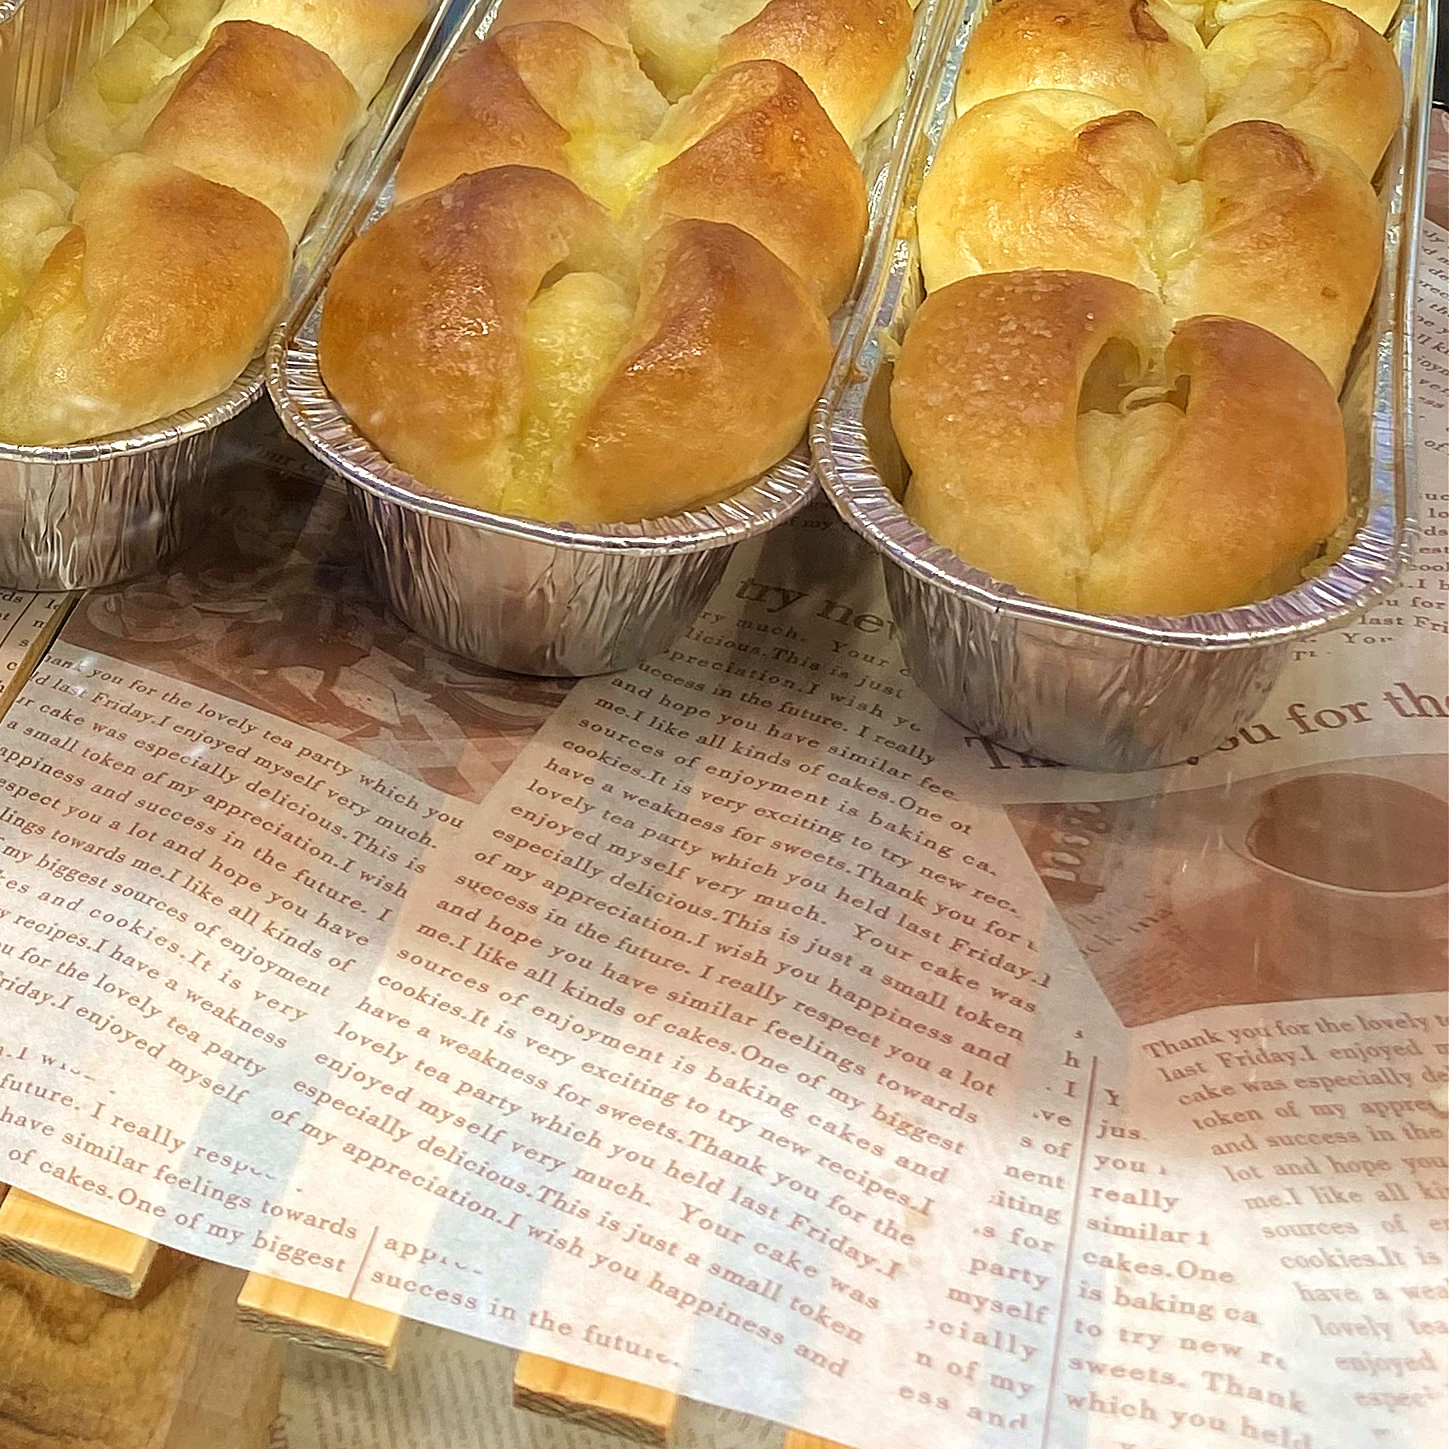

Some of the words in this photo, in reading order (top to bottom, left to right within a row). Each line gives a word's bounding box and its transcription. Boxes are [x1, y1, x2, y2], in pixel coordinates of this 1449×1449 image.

[50, 675, 88, 698] last
[173, 725, 252, 759] enjoyed
[253, 756, 326, 792] myself
[328, 789, 371, 817] very
[1286, 702, 1372, 734] for
[1383, 682, 1449, 718] th
[526, 779, 597, 814] lovely
[602, 810, 635, 829] tea
[638, 827, 703, 856] party
[711, 852, 778, 878] which
[783, 873, 828, 894] you
[835, 886, 891, 920] held
[896, 912, 942, 944] last
[107, 943, 160, 979] have
[164, 979, 178, 991] a
[186, 989, 286, 1048] weakness
[454, 875, 539, 914] success
[544, 908, 568, 928] in
[574, 922, 610, 944] the
[698, 965, 715, 980] I
[716, 975, 788, 1006] really
[792, 1000, 881, 1048] respect
[884, 1045, 932, 1071] you
[938, 1067, 953, 1080] a
[960, 1070, 996, 1097] lot
[8, 1149, 37, 1165] of
[174, 1213, 204, 1230] of
[205, 1223, 246, 1246] my
[251, 1229, 346, 1273] biggest
[271, 1110, 301, 1126] of
[298, 1122, 339, 1146] my
[528, 1225, 584, 1258] wish
[589, 1253, 640, 1282] you
[646, 1271, 784, 1345] happiness
[794, 1344, 850, 1378] and
